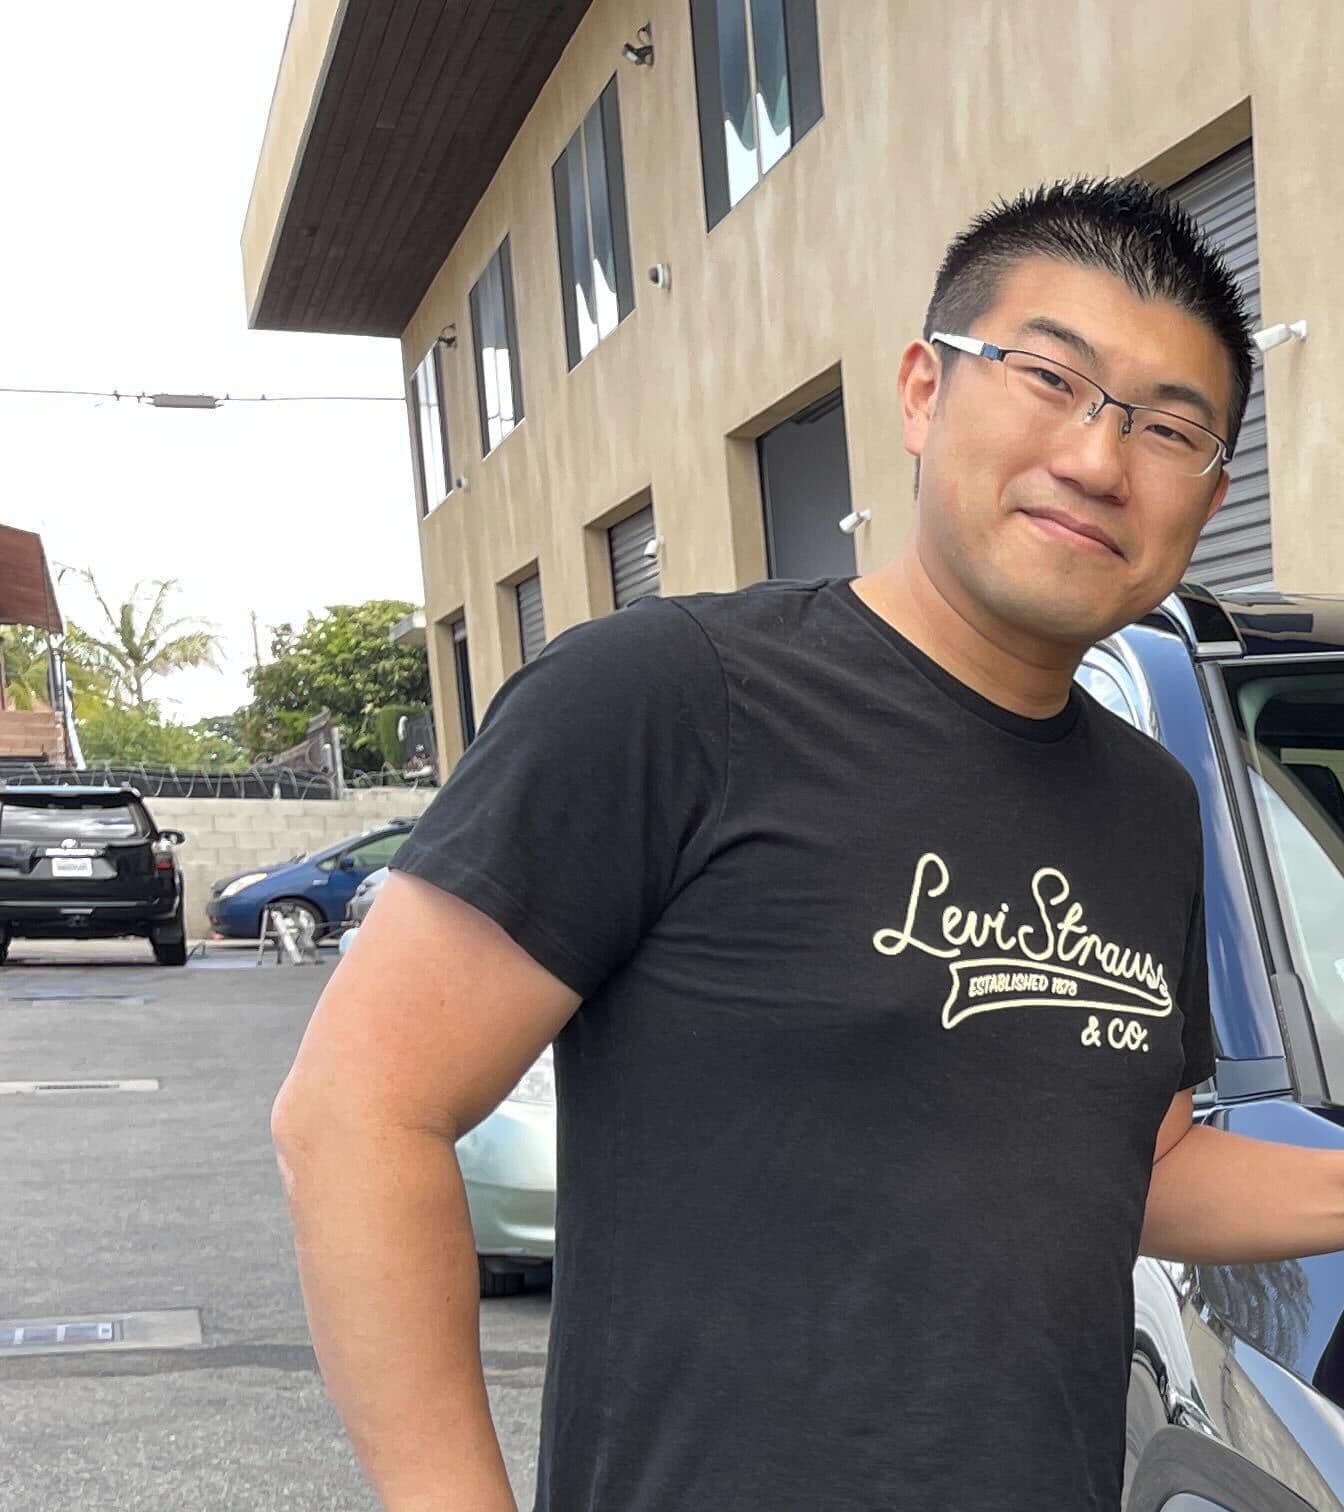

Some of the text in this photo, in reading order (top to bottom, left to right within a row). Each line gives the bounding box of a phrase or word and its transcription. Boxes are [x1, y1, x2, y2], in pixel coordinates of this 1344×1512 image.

[872, 853, 1172, 1000] Levi Strauss
[968, 973, 1049, 998] ESTABLISHED
[1081, 1015, 1149, 1052] & CO.
